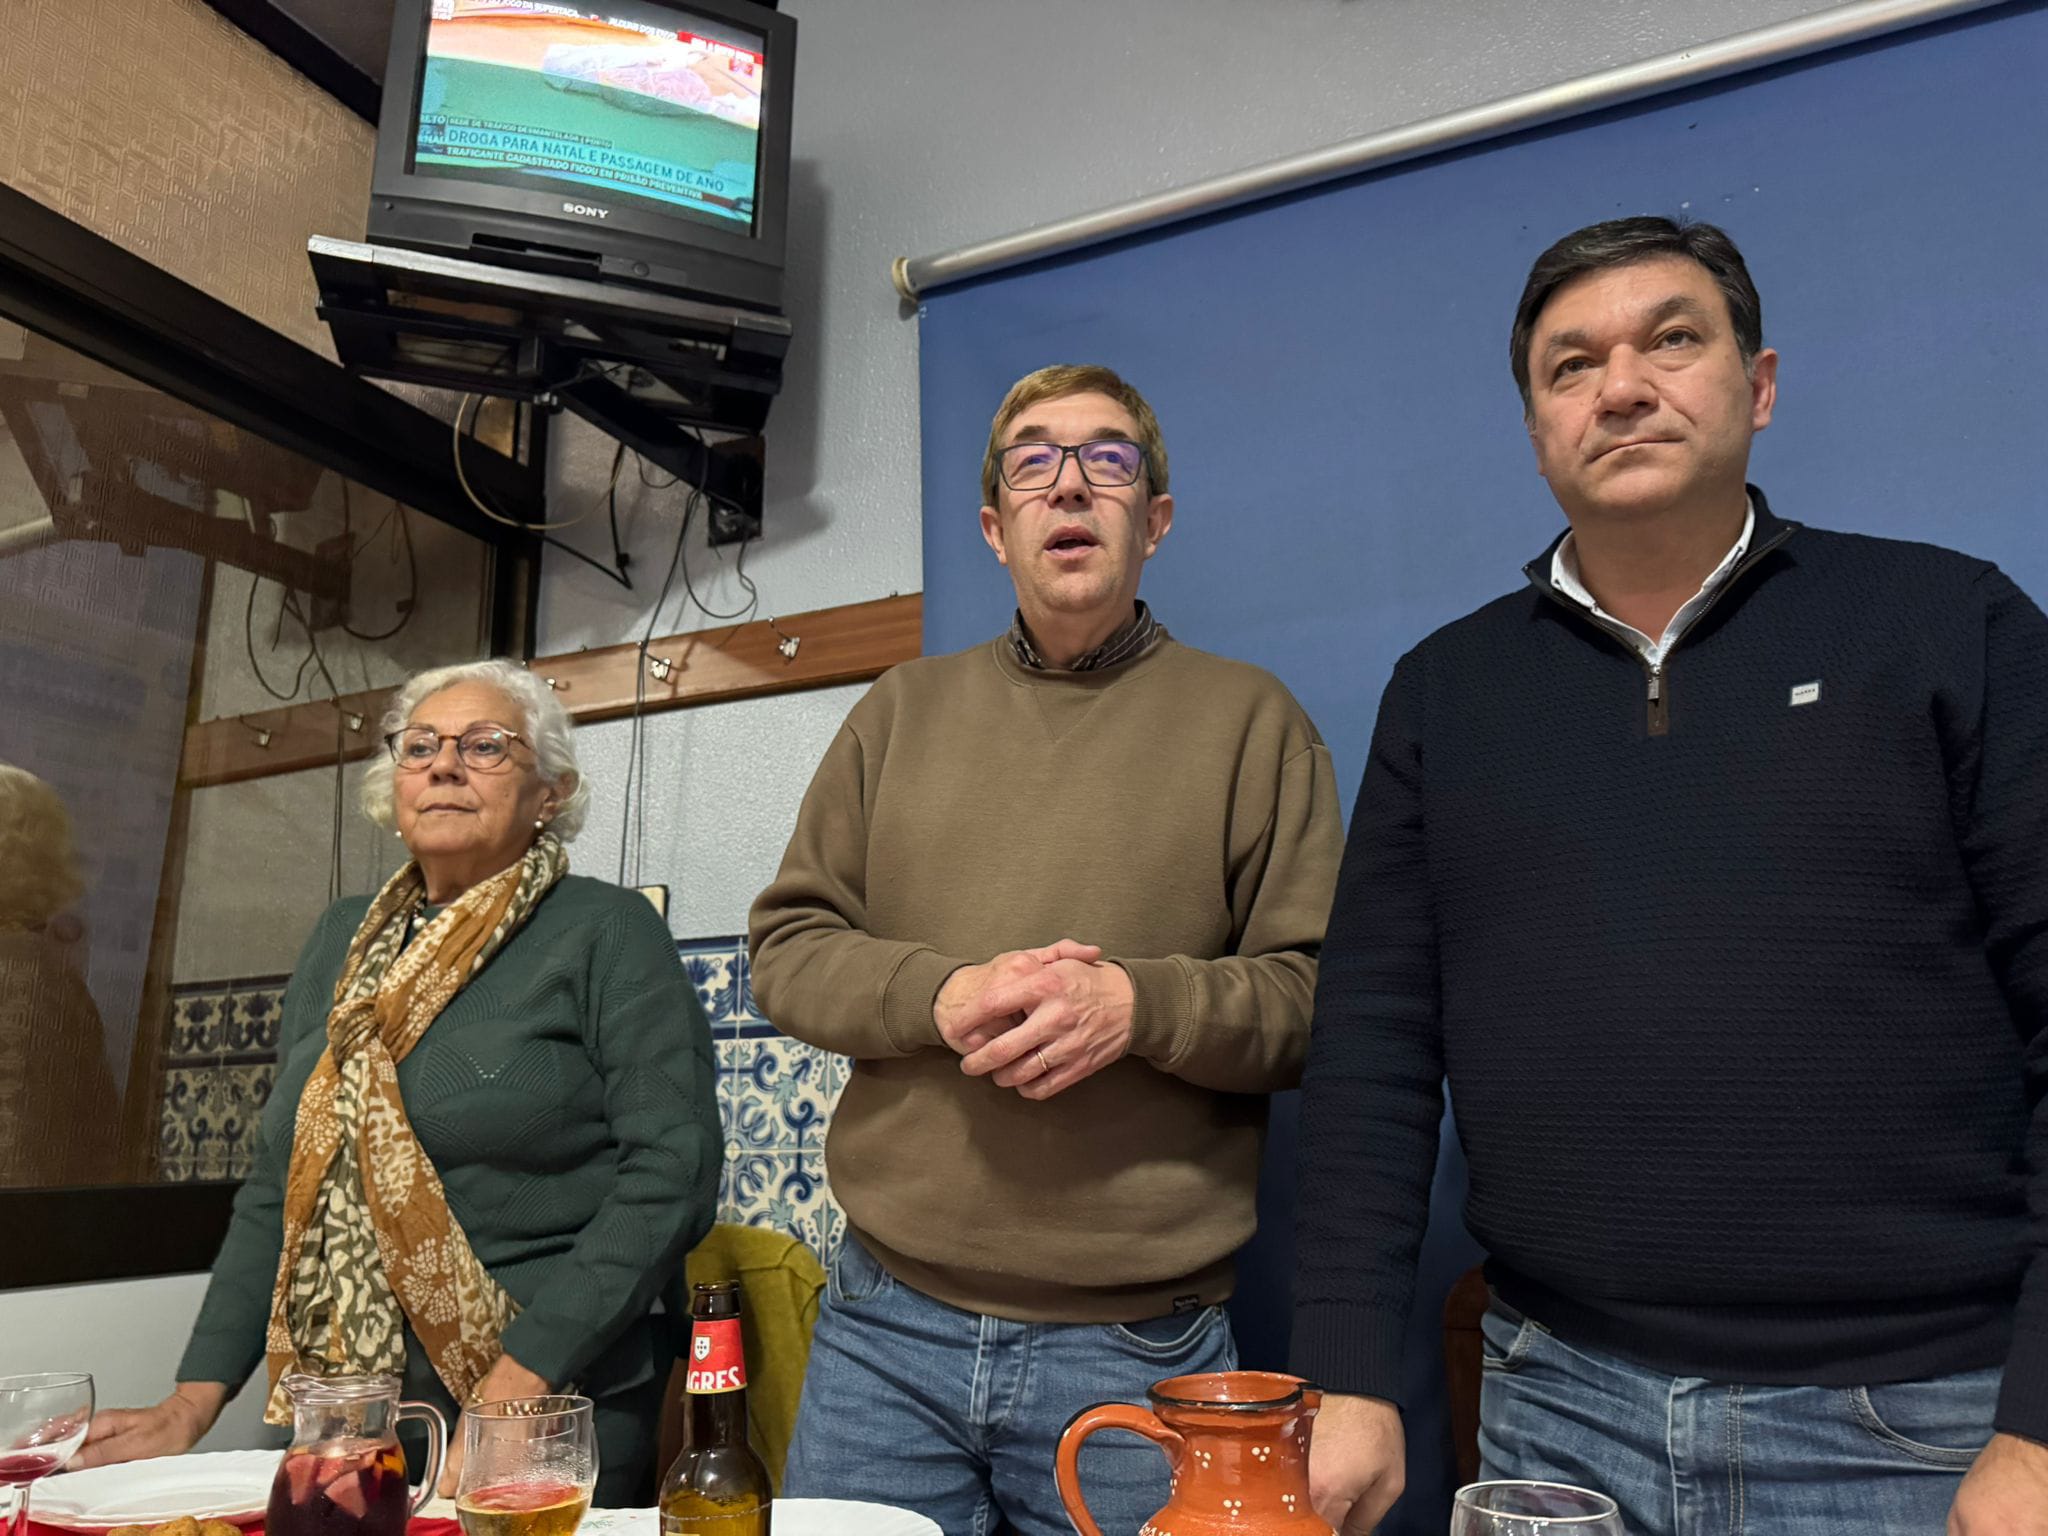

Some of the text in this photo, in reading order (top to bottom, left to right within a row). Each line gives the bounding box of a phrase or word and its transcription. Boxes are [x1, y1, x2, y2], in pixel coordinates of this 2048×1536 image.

[446, 146, 703, 200] TRAFICANTE CADASTRADO FICOU EM PRISÃO PREVENTIVA
[448, 129, 499, 146] DROGA
[502, 136, 538, 153] PARA
[542, 142, 585, 160] NATAL
[589, 150, 597, 162] E
[601, 151, 673, 179] PASSAGEM
[676, 170, 694, 184] DE
[696, 176, 725, 192] ANO
[563, 202, 609, 219] SONY
